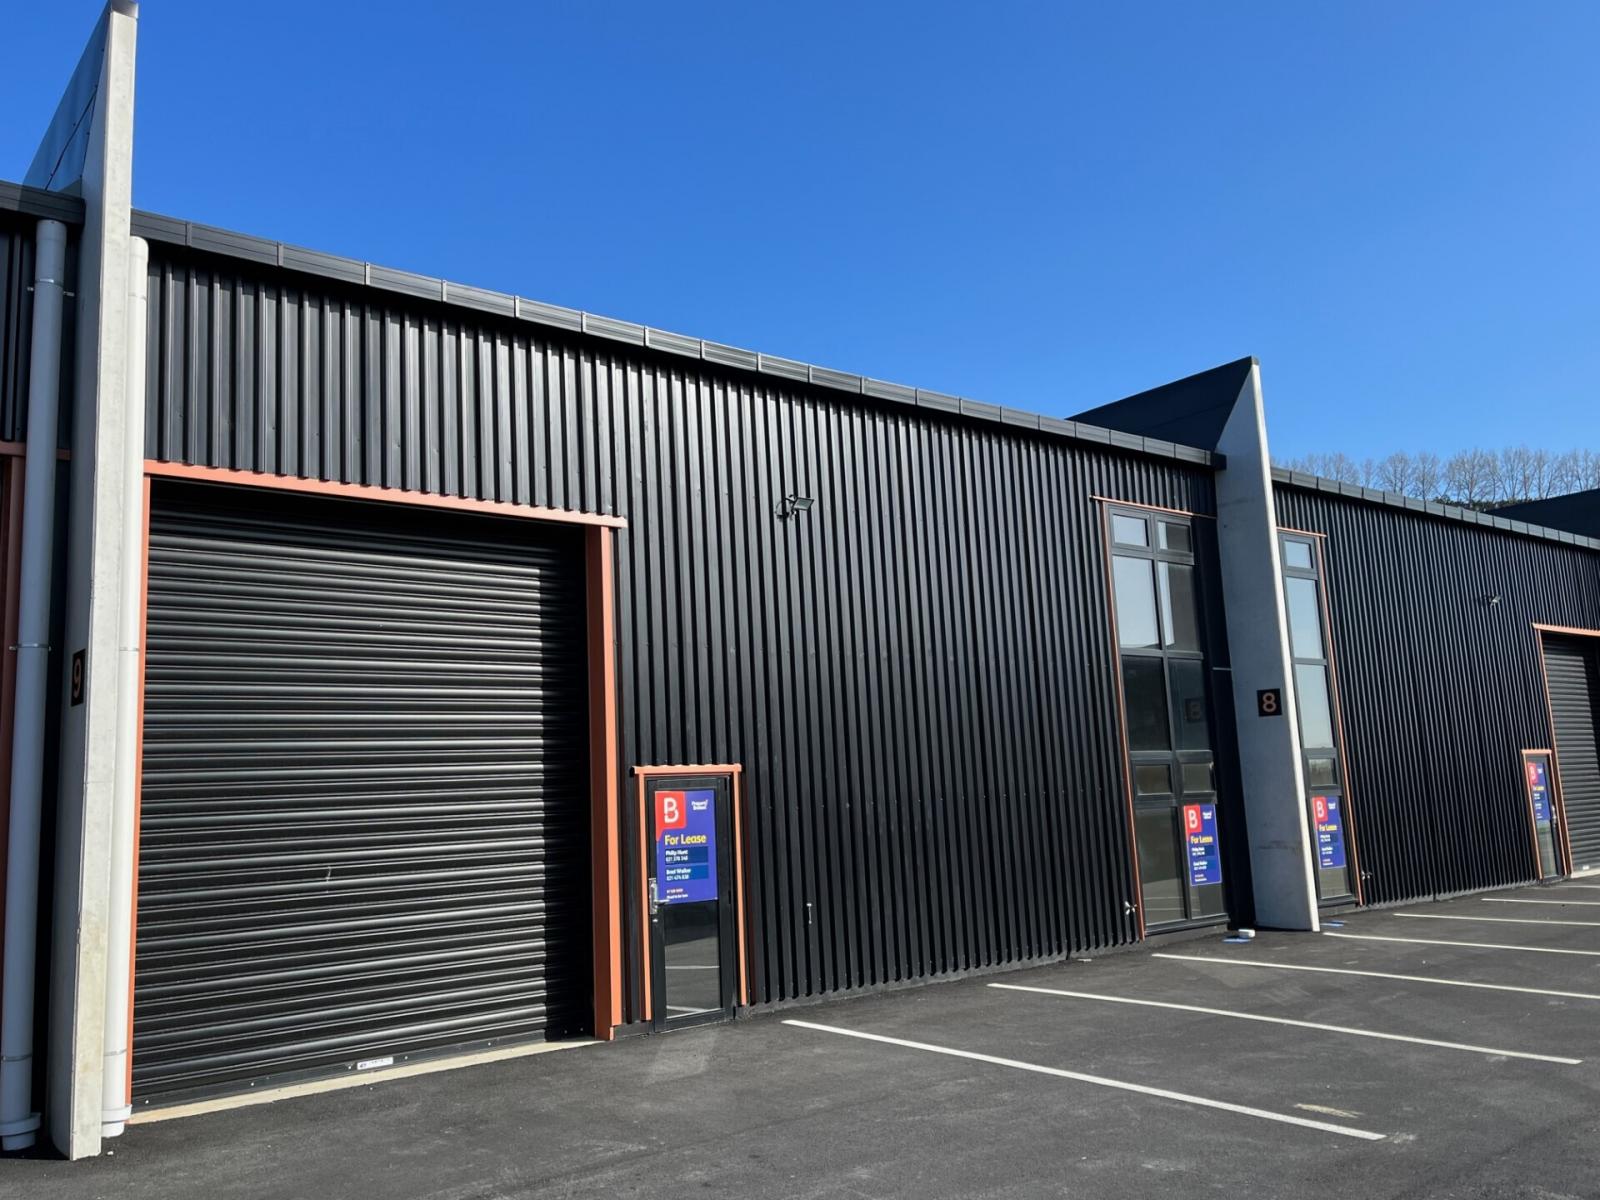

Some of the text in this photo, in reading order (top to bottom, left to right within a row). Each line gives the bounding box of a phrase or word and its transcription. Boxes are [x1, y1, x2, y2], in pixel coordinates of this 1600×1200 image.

[74, 658, 81, 698] 9
[1263, 692, 1276, 713] 8
[664, 797, 679, 823] B
[1188, 809, 1198, 829] B
[1316, 801, 1324, 818] B
[664, 834, 706, 845] For Lease
